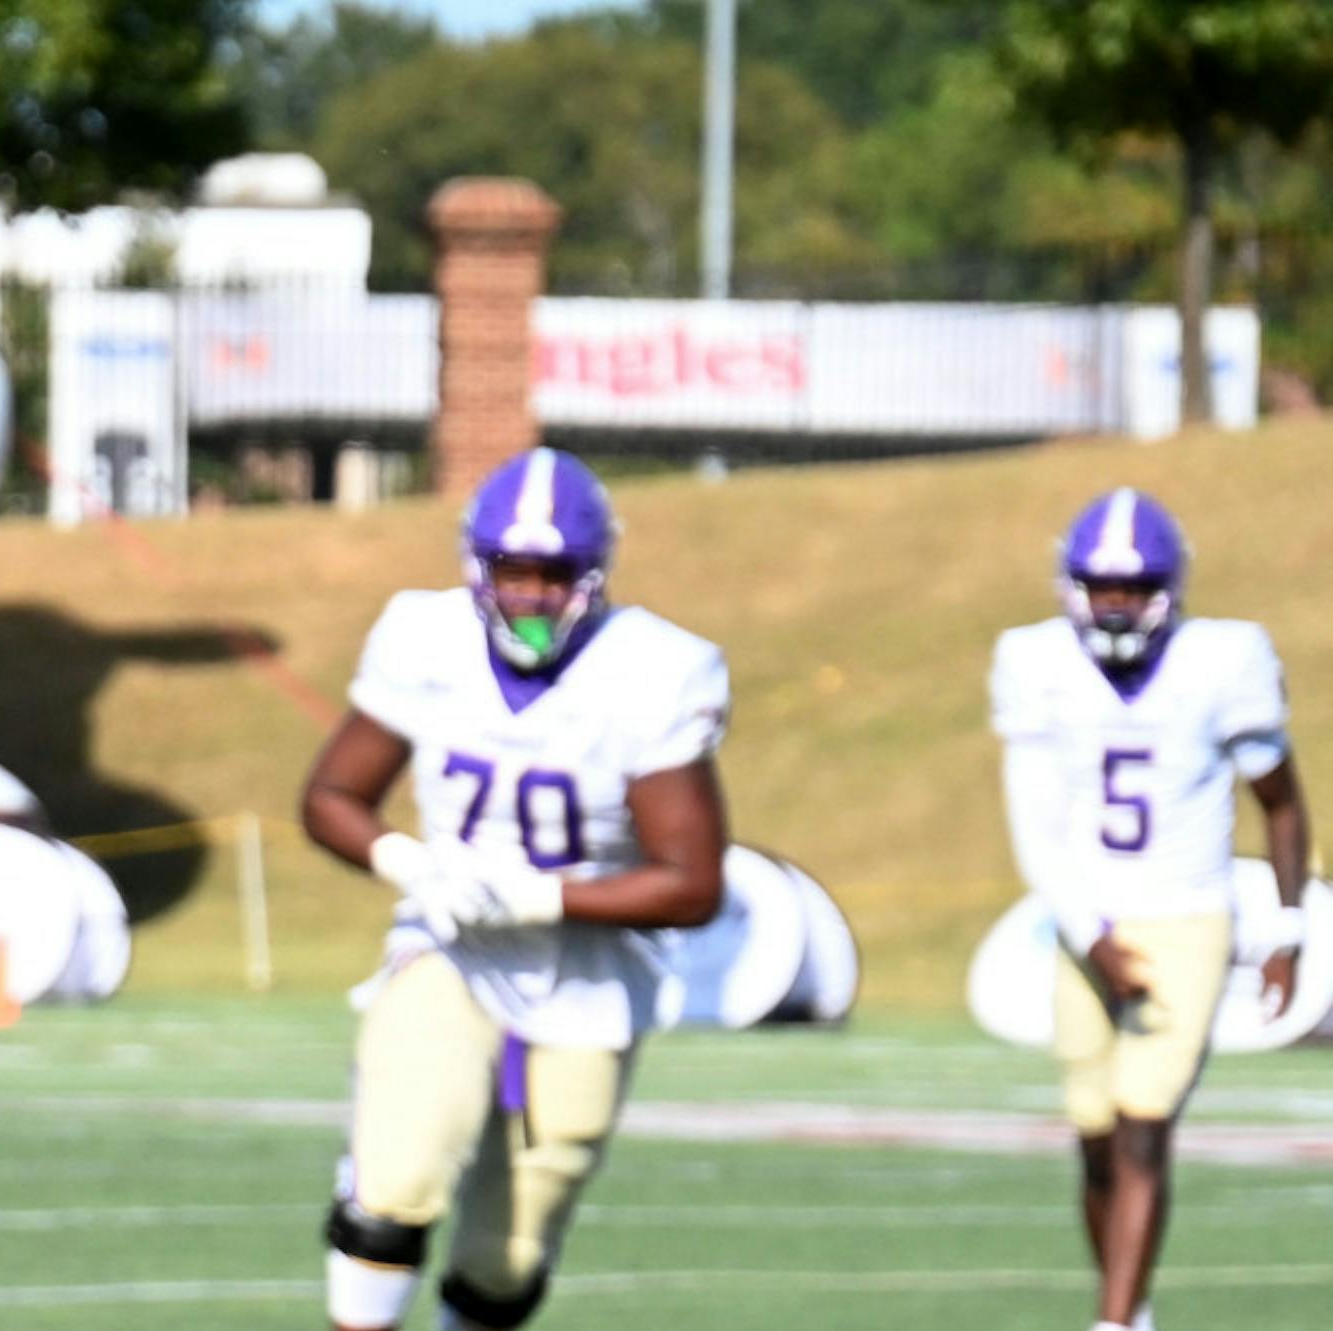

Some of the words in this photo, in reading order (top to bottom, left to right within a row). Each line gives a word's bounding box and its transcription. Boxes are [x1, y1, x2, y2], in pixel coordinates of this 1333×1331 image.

[529, 328, 805, 396] ngles
[443, 750, 583, 869] 70
[1100, 748, 1153, 853] 5
